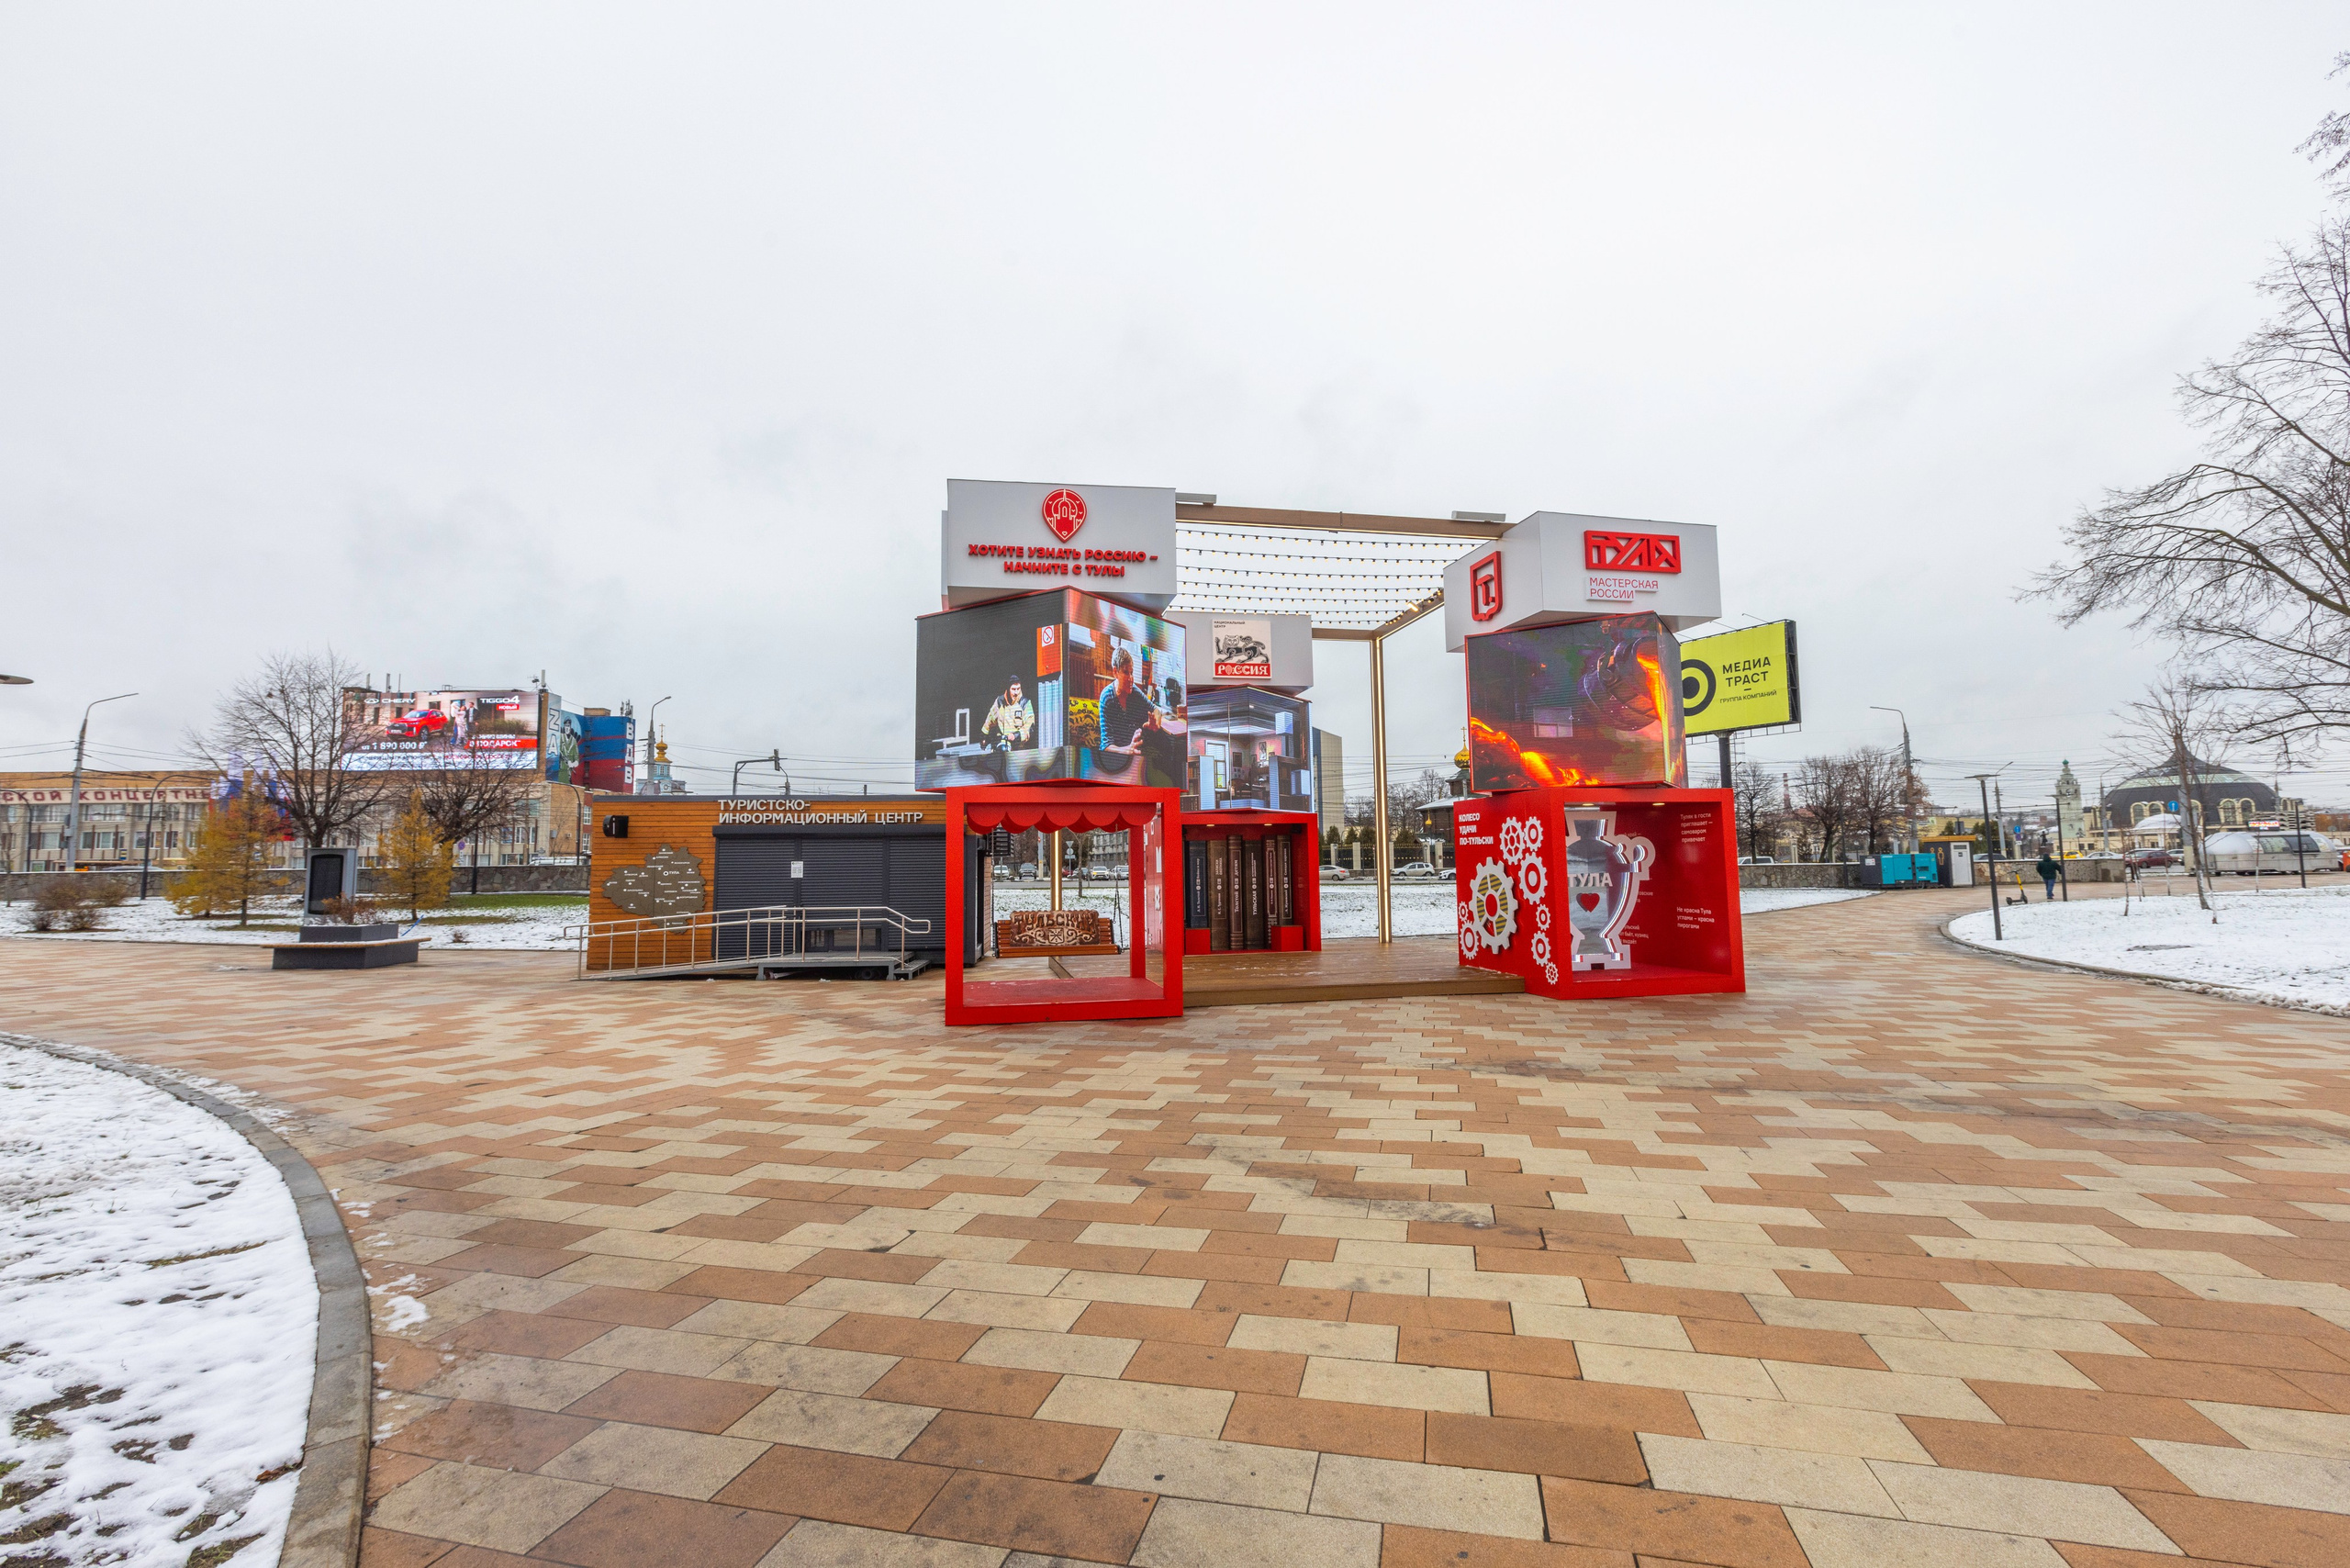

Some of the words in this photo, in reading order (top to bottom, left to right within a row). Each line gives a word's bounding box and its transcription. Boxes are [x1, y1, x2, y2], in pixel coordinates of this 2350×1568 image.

[968, 544, 1024, 557] ХОТИТЕ
[1027, 546, 1082, 560] УЗНАТЬ
[1085, 549, 1147, 562] РОССИЮ
[1003, 561, 1069, 575] НАЧНИТЕ
[1072, 564, 1082, 575] С
[1085, 565, 1125, 577] ТУЛЫ
[1589, 577, 1659, 589] МАСТЕРСКАЯ
[1590, 588, 1634, 599] РОССИИ
[1217, 665, 1269, 675] РОССИЯ
[1722, 656, 1771, 674] МЕДИА
[1726, 671, 1769, 687] ТРАСТ
[1743, 689, 1777, 700] КОМПАНИЙ
[624, 722, 634, 784] ВДВ
[80, 790, 210, 801] КОНЦЕРТНЫ
[718, 799, 811, 811] ТУРИСТСКО-
[719, 809, 867, 825] ИНФОРМАЦИОННЫЙ
[875, 812, 923, 824] ЦЕНТР
[1459, 812, 1481, 823] КОЛЕСО
[1459, 825, 1477, 834] УДАЧИ
[1460, 836, 1494, 846] ПО-ТУЛЬСКИ
[1567, 872, 1613, 888] ТУЛА
